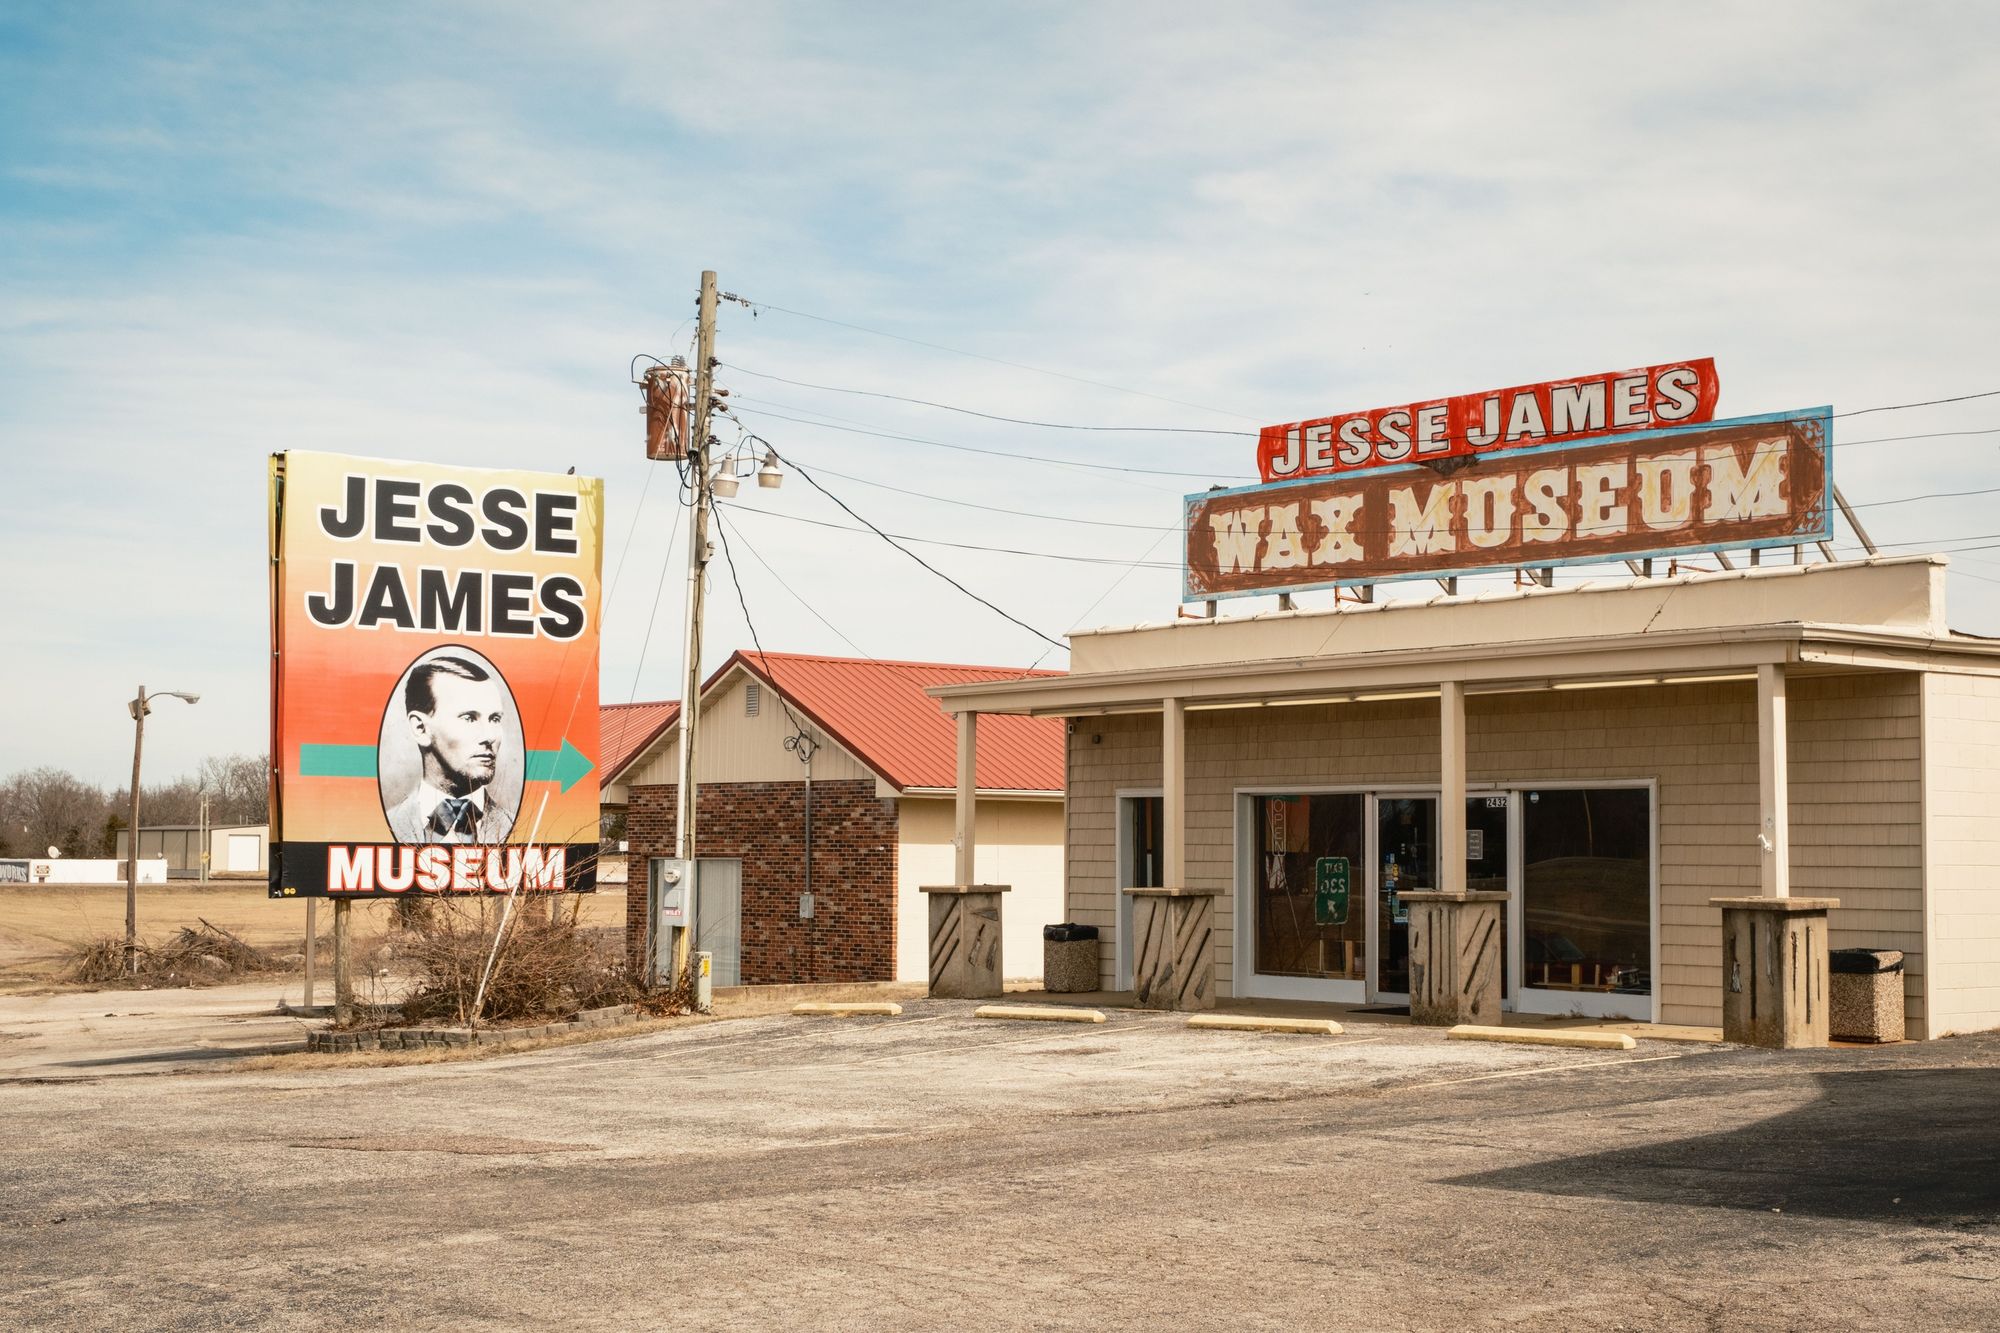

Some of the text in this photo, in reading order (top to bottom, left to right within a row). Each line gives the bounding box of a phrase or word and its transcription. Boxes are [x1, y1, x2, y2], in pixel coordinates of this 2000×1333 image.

[1271, 368, 1699, 476] JESSE JAMES
[319, 475, 579, 555] JESSE
[1209, 440, 1791, 574] WAX MUSEUM
[307, 562, 585, 639] JAMES
[1273, 798, 1285, 853] OPEN
[1487, 798, 1507, 807] 2432
[327, 844, 567, 892] MUSEUM
